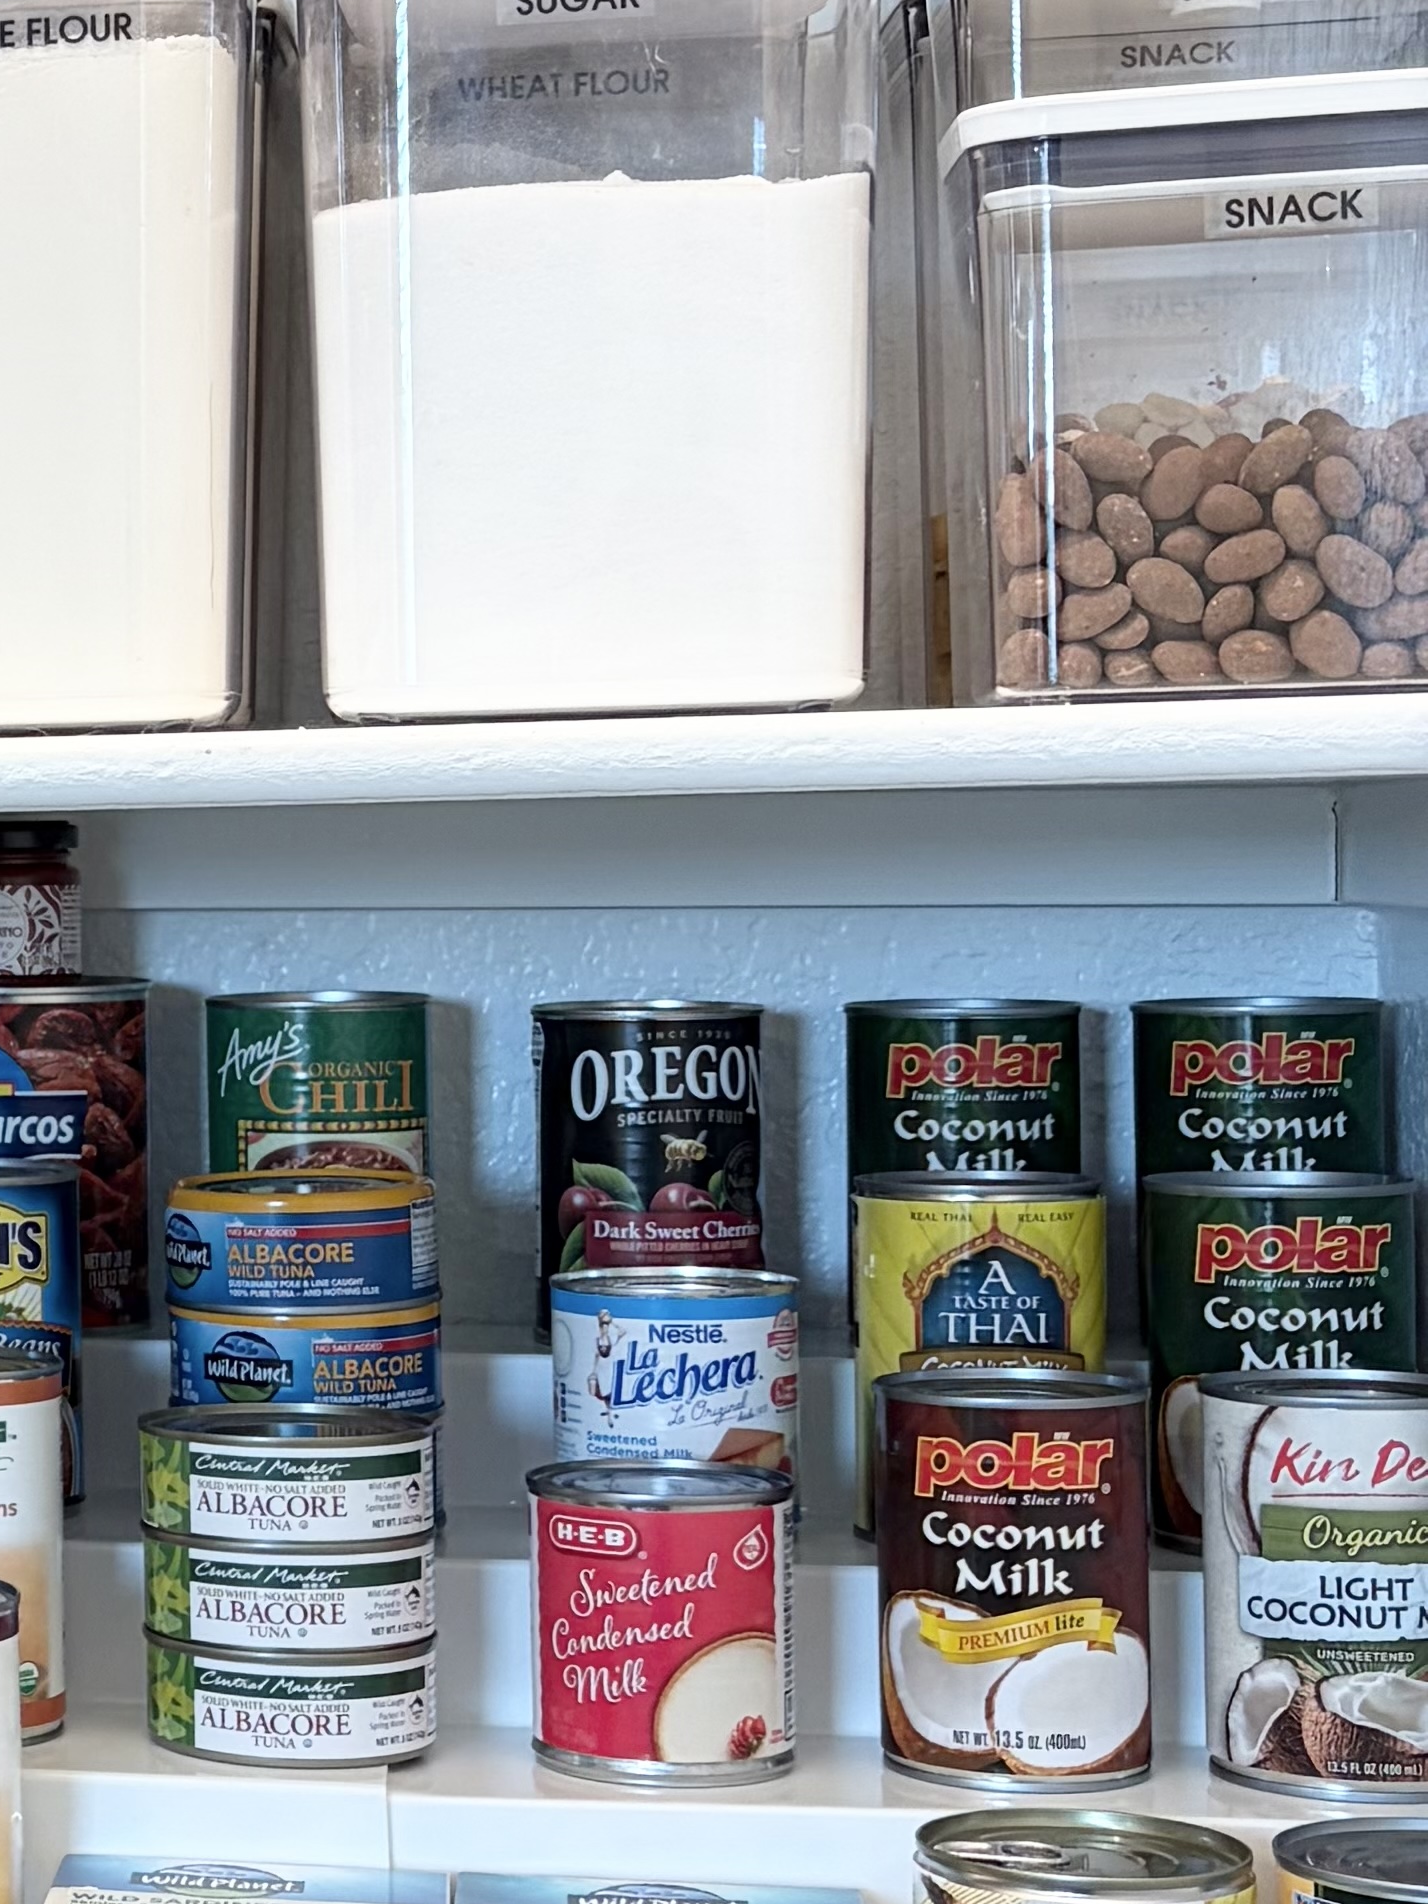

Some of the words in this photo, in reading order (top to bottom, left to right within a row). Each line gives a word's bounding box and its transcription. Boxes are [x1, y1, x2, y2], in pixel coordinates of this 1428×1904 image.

[26, 11, 133, 46] FLOUR
[1119, 39, 1236, 69] SNACK
[457, 69, 564, 101] WHEAT
[572, 66, 671, 96] FLOUR
[1224, 188, 1365, 229] SNACK
[217, 1019, 306, 1096] Amy's
[307, 1060, 396, 1077] ORGANIC
[260, 1061, 414, 1116] CHILI
[570, 1045, 766, 1123] OREGON
[616, 1108, 702, 1127] SPECIALTY
[893, 1108, 1056, 1142] Coconut
[592, 1219, 645, 1242] Dark
[649, 1220, 699, 1242] Sweet
[227, 1241, 355, 1265] ALBACORE
[227, 1265, 262, 1279] WILD
[265, 1265, 315, 1279] TUNA
[977, 1259, 1017, 1295] A
[953, 1294, 1007, 1310] TASTE
[1011, 1295, 1039, 1311] OF
[938, 1311, 1049, 1345] THAI
[625, 1340, 660, 1378] La
[611, 1351, 757, 1406] Lechera
[196, 1492, 349, 1519] ALBACORE
[247, 1518, 293, 1532] TUNA
[922, 1510, 1105, 1551] Coconut
[568, 1552, 717, 1617] Sweetened
[955, 1558, 1074, 1597] Milk
[1317, 1574, 1409, 1603] LIGHT
[957, 1623, 1050, 1651] PREMIUM
[1054, 1610, 1086, 1635] lite
[1247, 1599, 1412, 1629] COCONUT
[552, 1612, 694, 1662] Condensed
[1316, 1649, 1415, 1664] UNSWEETENED
[563, 1664, 648, 1705] Milk
